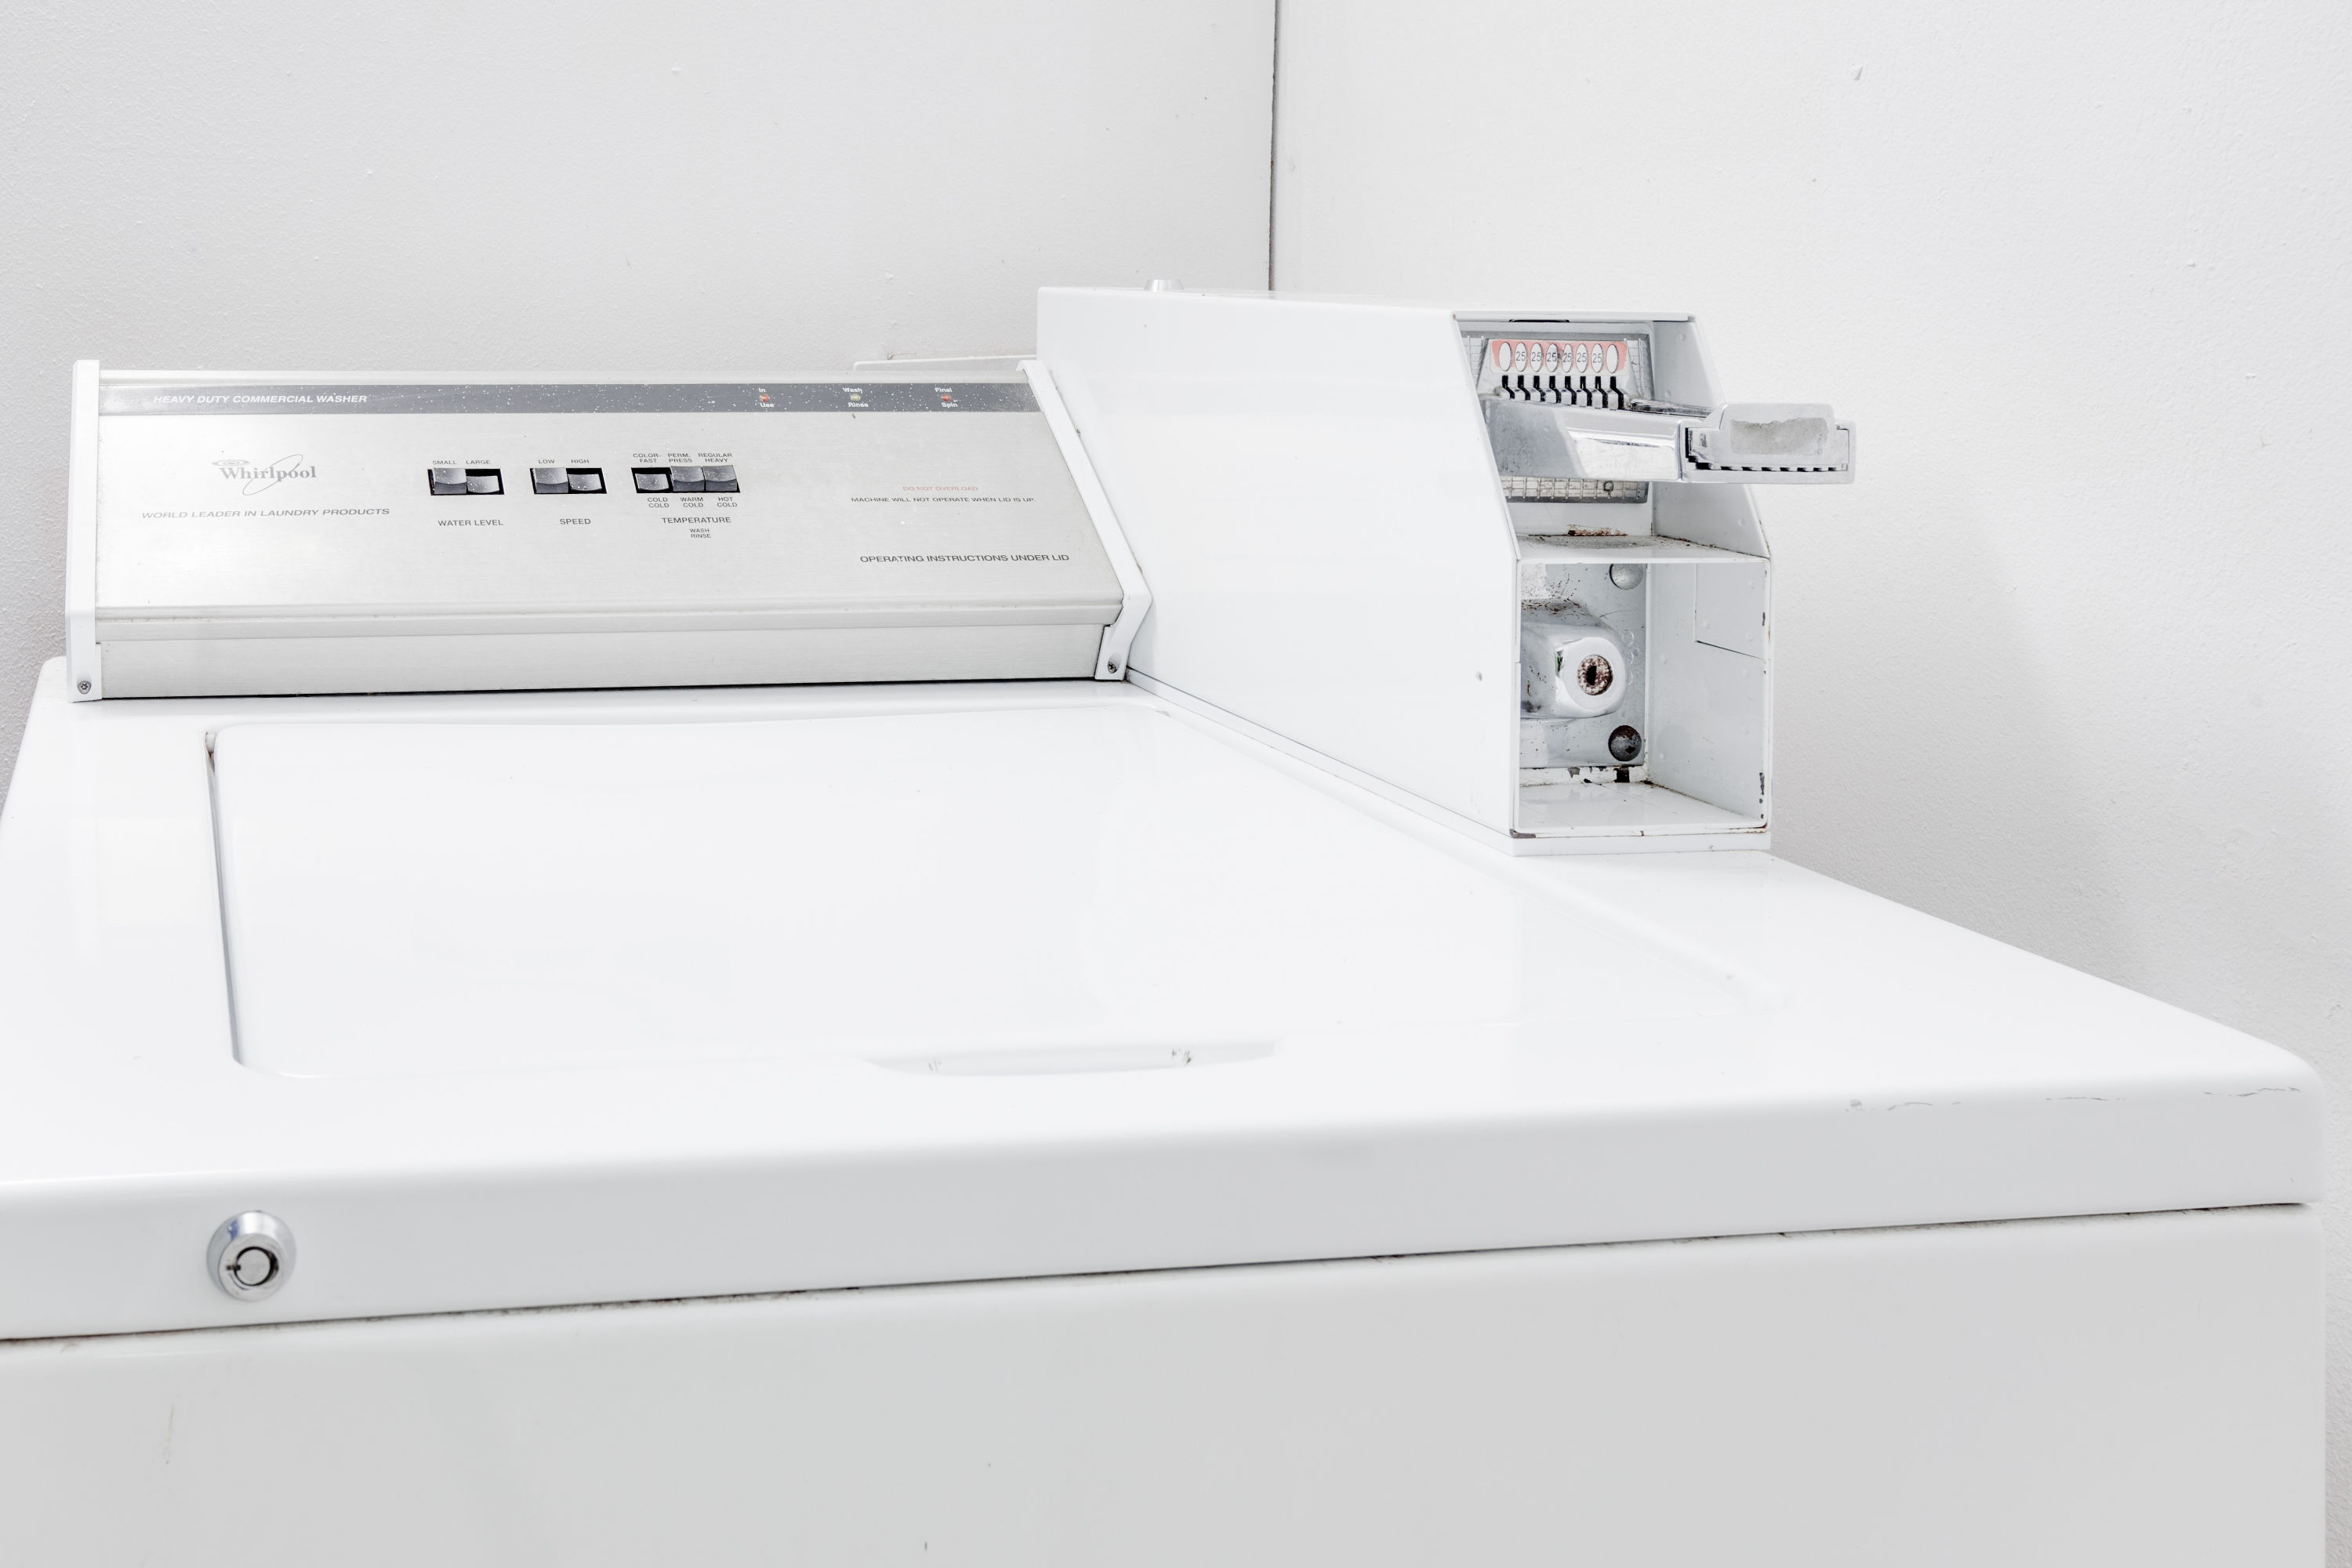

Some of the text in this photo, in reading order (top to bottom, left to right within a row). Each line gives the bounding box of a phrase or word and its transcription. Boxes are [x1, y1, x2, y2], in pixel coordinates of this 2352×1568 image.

[1515, 351, 1602, 363] 25 25 25 25 25 25
[233, 394, 314, 403] COMMERCIAL
[316, 394, 368, 403] WASHER
[219, 466, 318, 482] Whirlpool
[260, 509, 319, 517] LAUNDRY
